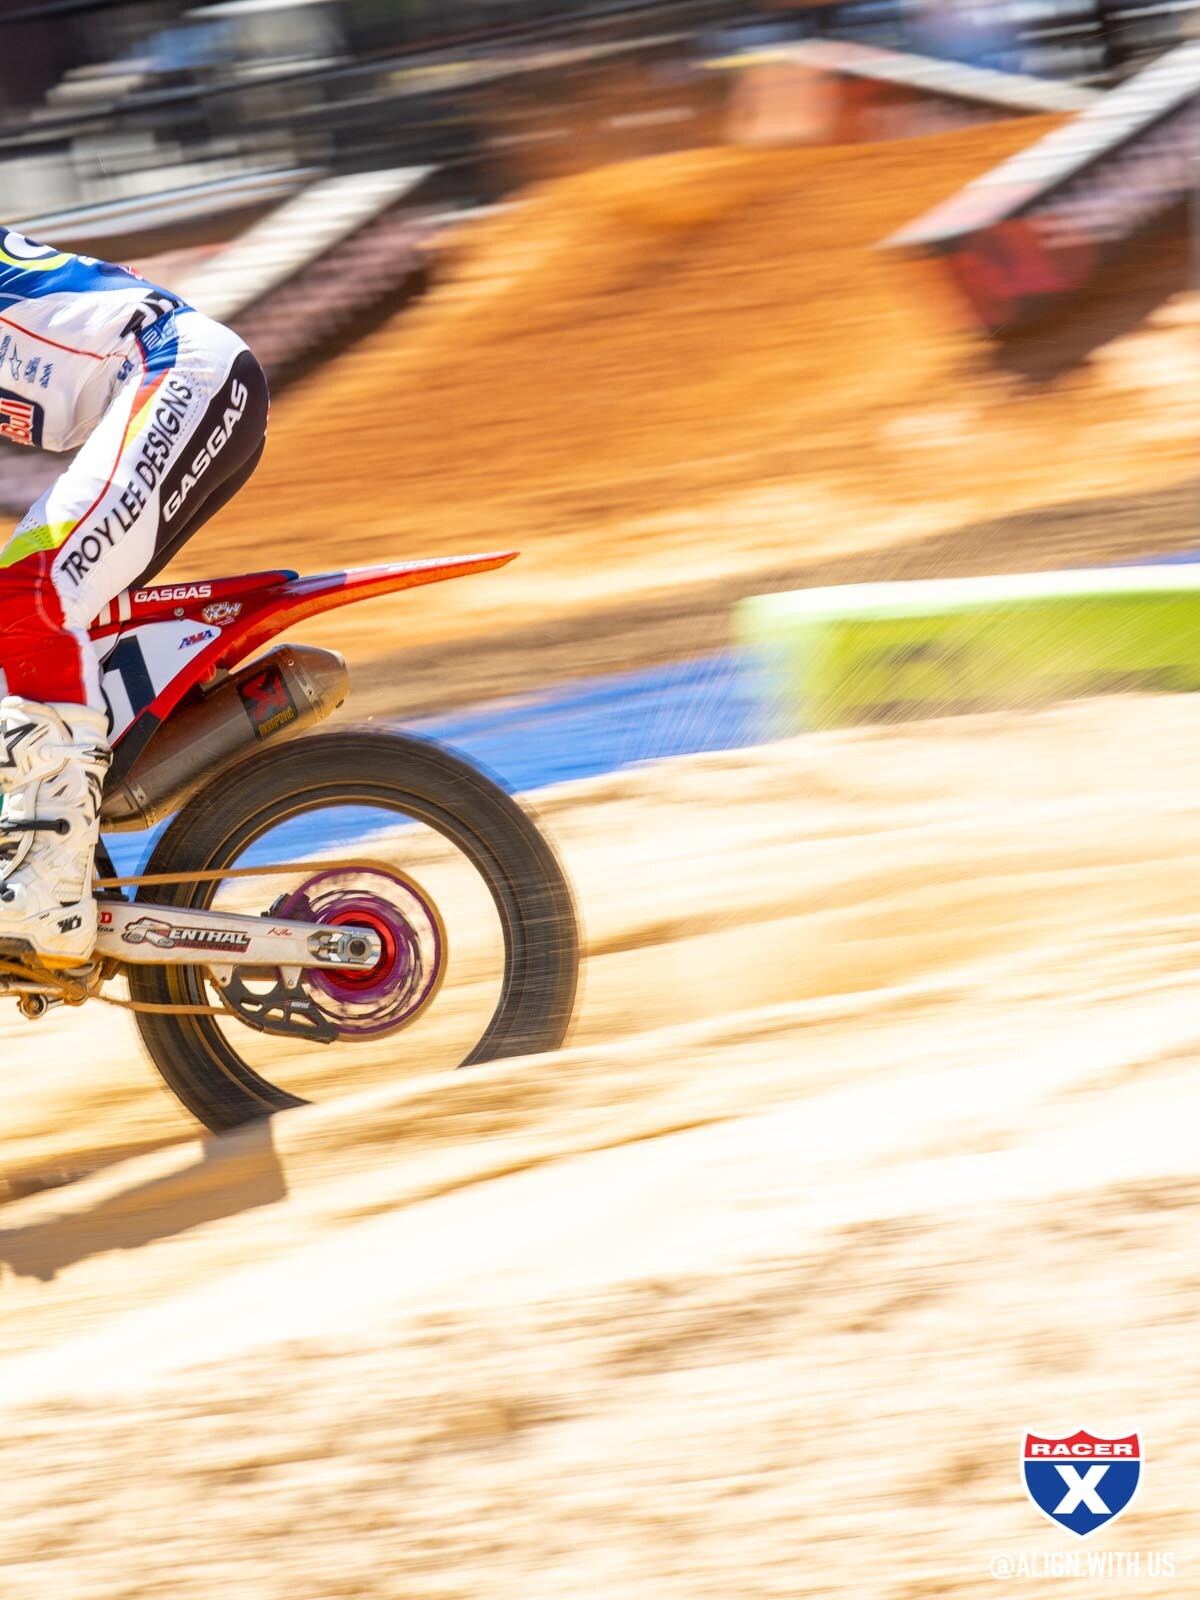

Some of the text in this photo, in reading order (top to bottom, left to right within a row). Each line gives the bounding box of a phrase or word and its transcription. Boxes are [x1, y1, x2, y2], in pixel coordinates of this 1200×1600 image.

[60, 516, 117, 586] TROY
[111, 477, 146, 534] LEE
[137, 380, 193, 491] DESIGNS
[162, 379, 249, 523] GASGAS
[134, 585, 212, 603] GASGAS
[178, 629, 214, 650] AMA
